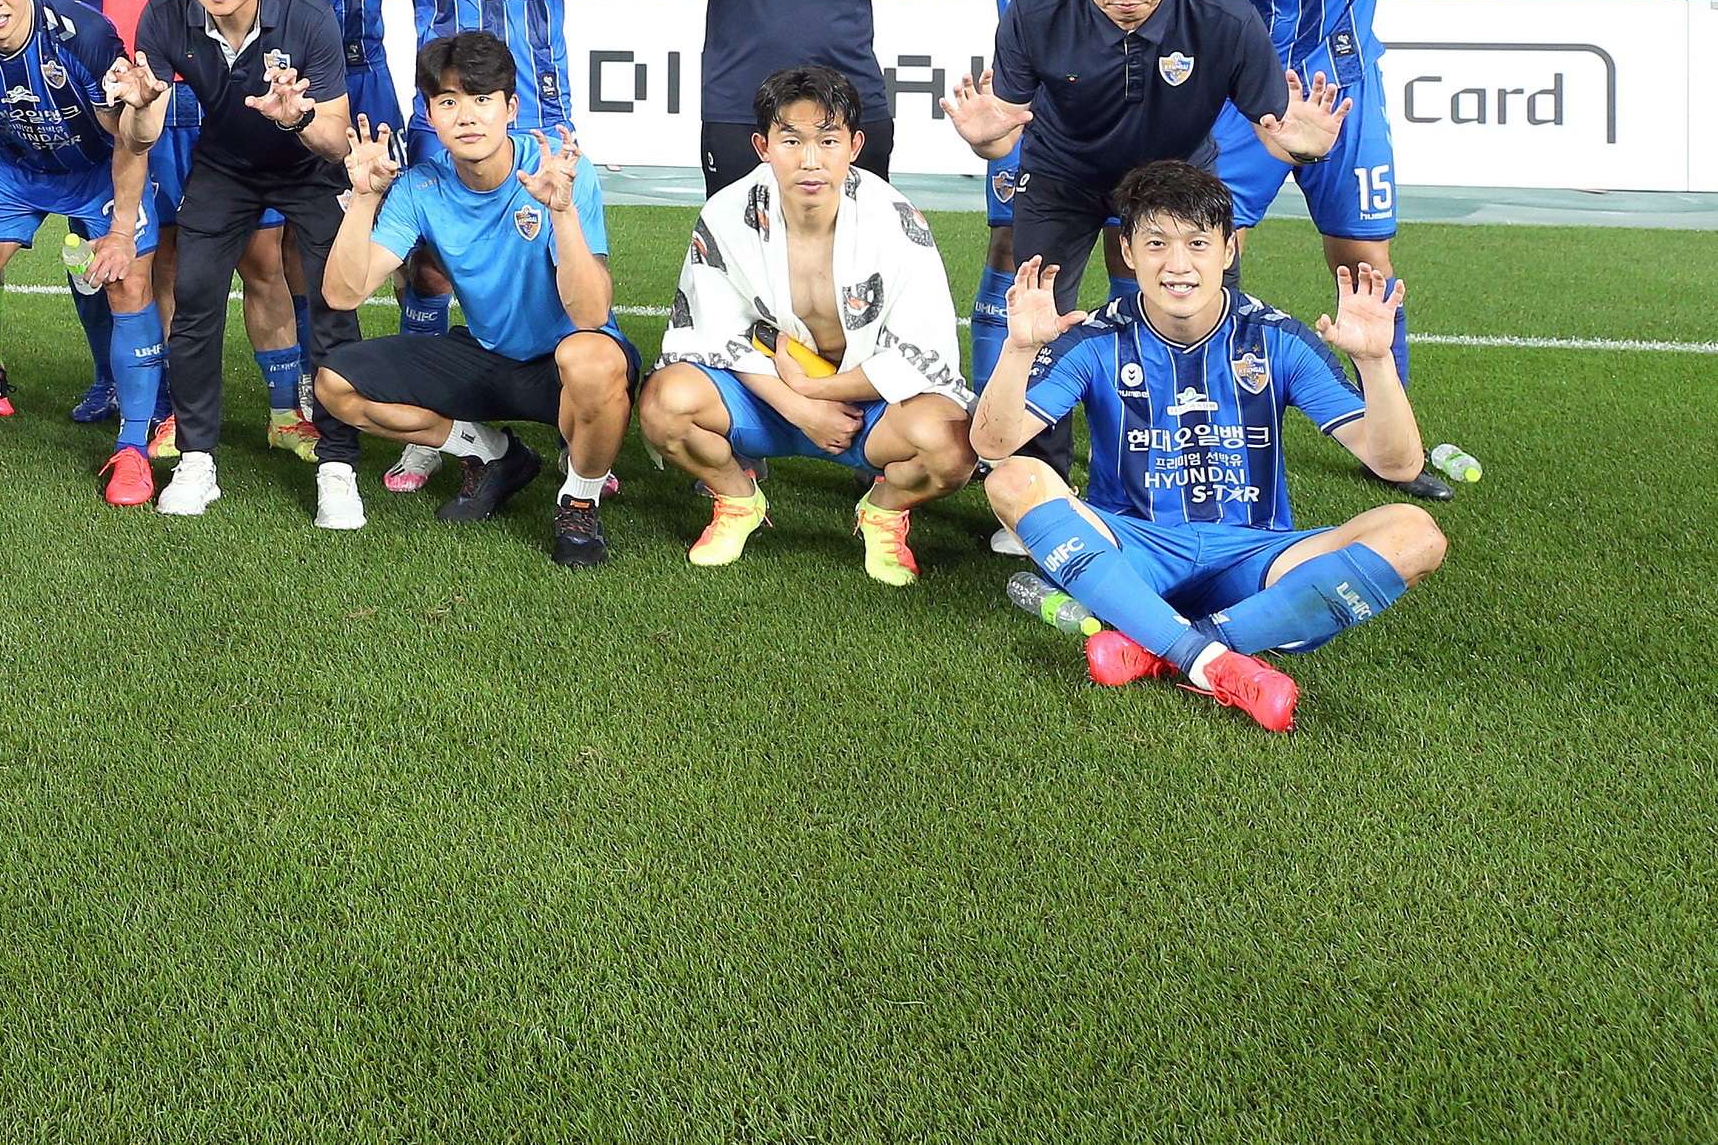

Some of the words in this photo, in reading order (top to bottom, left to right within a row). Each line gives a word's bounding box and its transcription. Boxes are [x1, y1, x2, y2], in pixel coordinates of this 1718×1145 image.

[1404, 72, 1564, 126] Card
[1354, 164, 1393, 211] 15
[1127, 423, 1272, 453] 현대오일뱅크
[1155, 453, 1201, 470] 프리미엄
[1205, 451, 1243, 467] 선박유
[1144, 467, 1247, 489] HYUNDAI
[1043, 536, 1085, 573] UHFC
